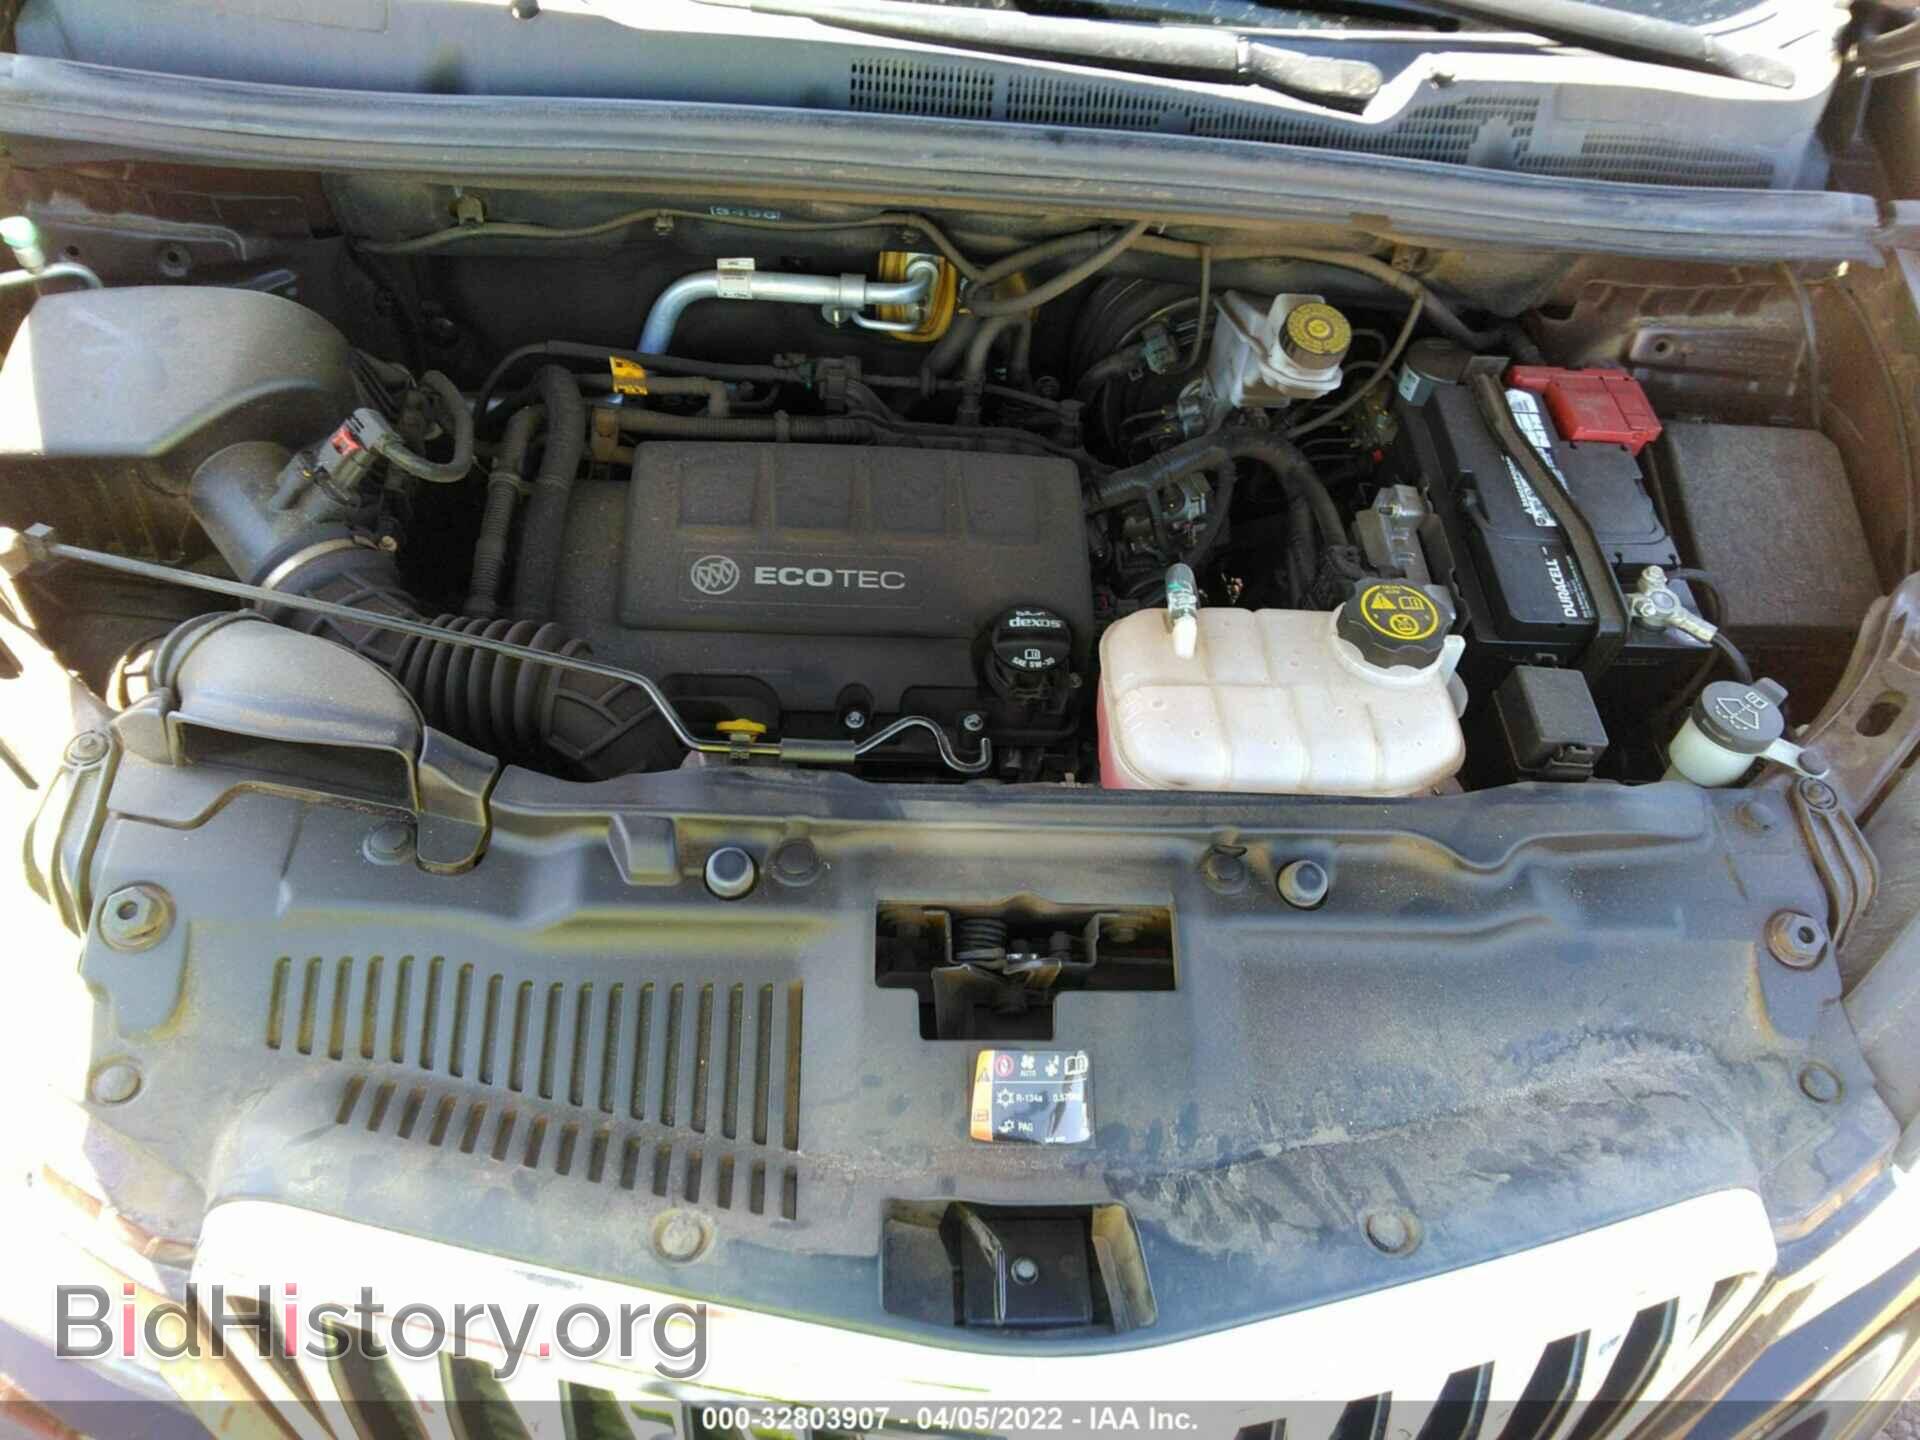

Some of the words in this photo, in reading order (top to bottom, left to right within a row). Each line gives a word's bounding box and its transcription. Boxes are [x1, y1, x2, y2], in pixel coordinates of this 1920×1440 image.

[754, 566, 906, 590] ECOTEC
[1545, 559, 1578, 617] DURACELL
[1009, 616, 1063, 629] dexos
